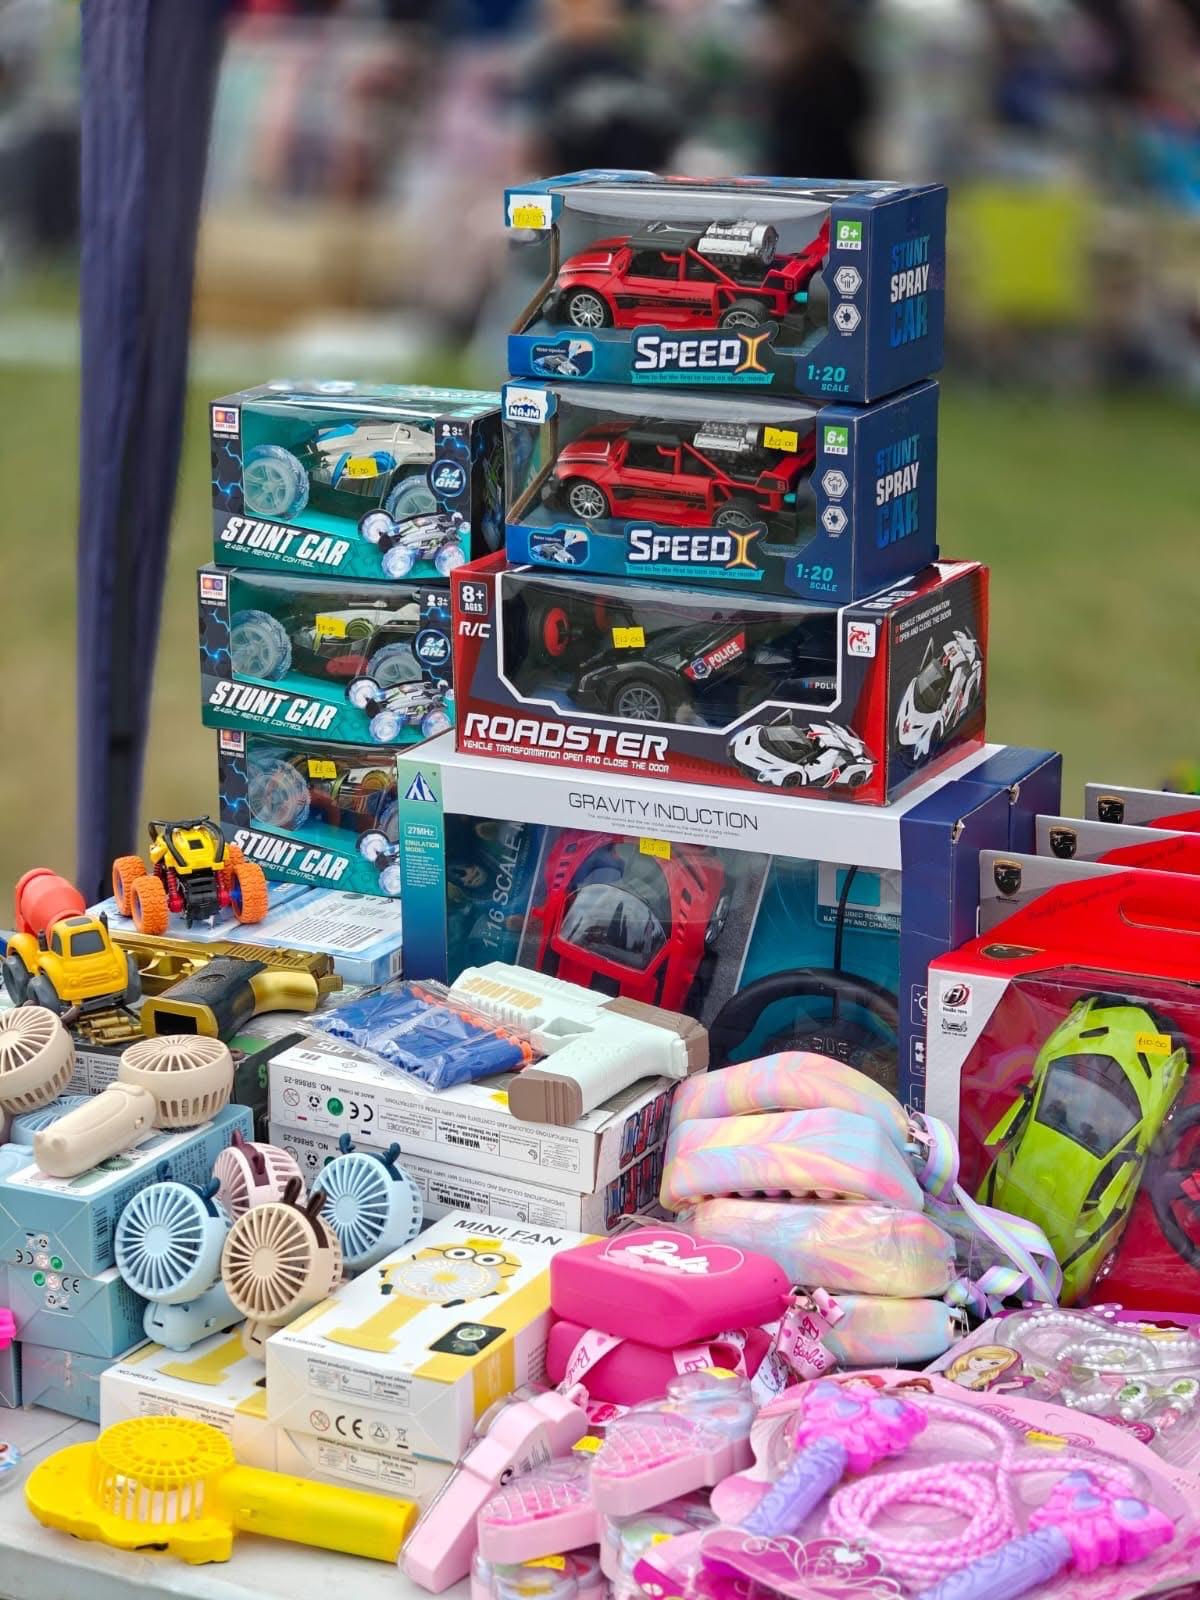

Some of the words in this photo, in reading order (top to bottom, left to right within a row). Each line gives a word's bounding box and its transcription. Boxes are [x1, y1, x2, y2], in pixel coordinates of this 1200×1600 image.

[840, 225, 858, 240] 6+
[892, 234, 930, 272] STUNT
[890, 264, 930, 303] SPRAY
[889, 294, 928, 348] CAR
[807, 364, 846, 382] 1:20
[822, 383, 849, 393] SCALE
[510, 404, 540, 419] NAJM
[826, 430, 844, 444] 6+
[875, 434, 920, 476] STUNT
[440, 468, 460, 478] 2.4
[435, 478, 461, 488] GHz
[876, 462, 920, 507] SPRAY
[876, 491, 918, 550] CAR
[220, 516, 302, 554] STUNT
[296, 534, 350, 566] CAR
[252, 548, 280, 560] REMOTE
[282, 555, 315, 568] CONTROL
[796, 564, 834, 582] 1:20
[462, 586, 484, 602] 8+
[810, 582, 838, 592] SCALE
[464, 603, 483, 612] AGES
[916, 600, 950, 622] TRANSFORMATION
[458, 620, 492, 638] R/C
[424, 637, 446, 647] 2.4
[420, 647, 446, 657] GHz
[708, 641, 740, 668] POLICE
[208, 680, 290, 718] STUNT
[284, 698, 338, 730] CAR
[240, 712, 270, 724] REMOTE
[270, 719, 304, 732] CONTROL
[464, 712, 670, 760] ROADSTER
[464, 740, 494, 751] VEHICLE
[496, 744, 561, 759] TRANSFORMATION
[563, 752, 583, 762] OPEN
[586, 755, 600, 765] AND
[603, 758, 628, 768] CLOSE
[632, 760, 646, 770] THE
[648, 763, 670, 774] DOOR
[568, 792, 650, 816] GRAVITY
[654, 803, 758, 830] INDUCTION
[407, 826, 434, 836] 27MHz
[404, 840, 440, 848] EMULATION
[404, 846, 426, 854] MODEL
[230, 830, 304, 866] STUNT
[299, 849, 350, 881] CAR
[286, 868, 316, 882] CONTROL
[492, 832, 522, 906] SCALE
[830, 908, 864, 919] INUDED
[483, 908, 505, 948] 1:16
[284, 1076, 317, 1089] SR868-25
[319, 1082, 332, 1092] NO.
[467, 1116, 496, 1126] CONTENTS
[313, 1140, 329, 1151] NO.
[444, 1134, 480, 1149] WARNING:
[535, 1130, 579, 1144] SPECIFICATIONS
[437, 1194, 470, 1210] WARNING:
[454, 1220, 508, 1236] MINI
[508, 1230, 563, 1246] FAN
[793, 1336, 824, 1370] Barbie
